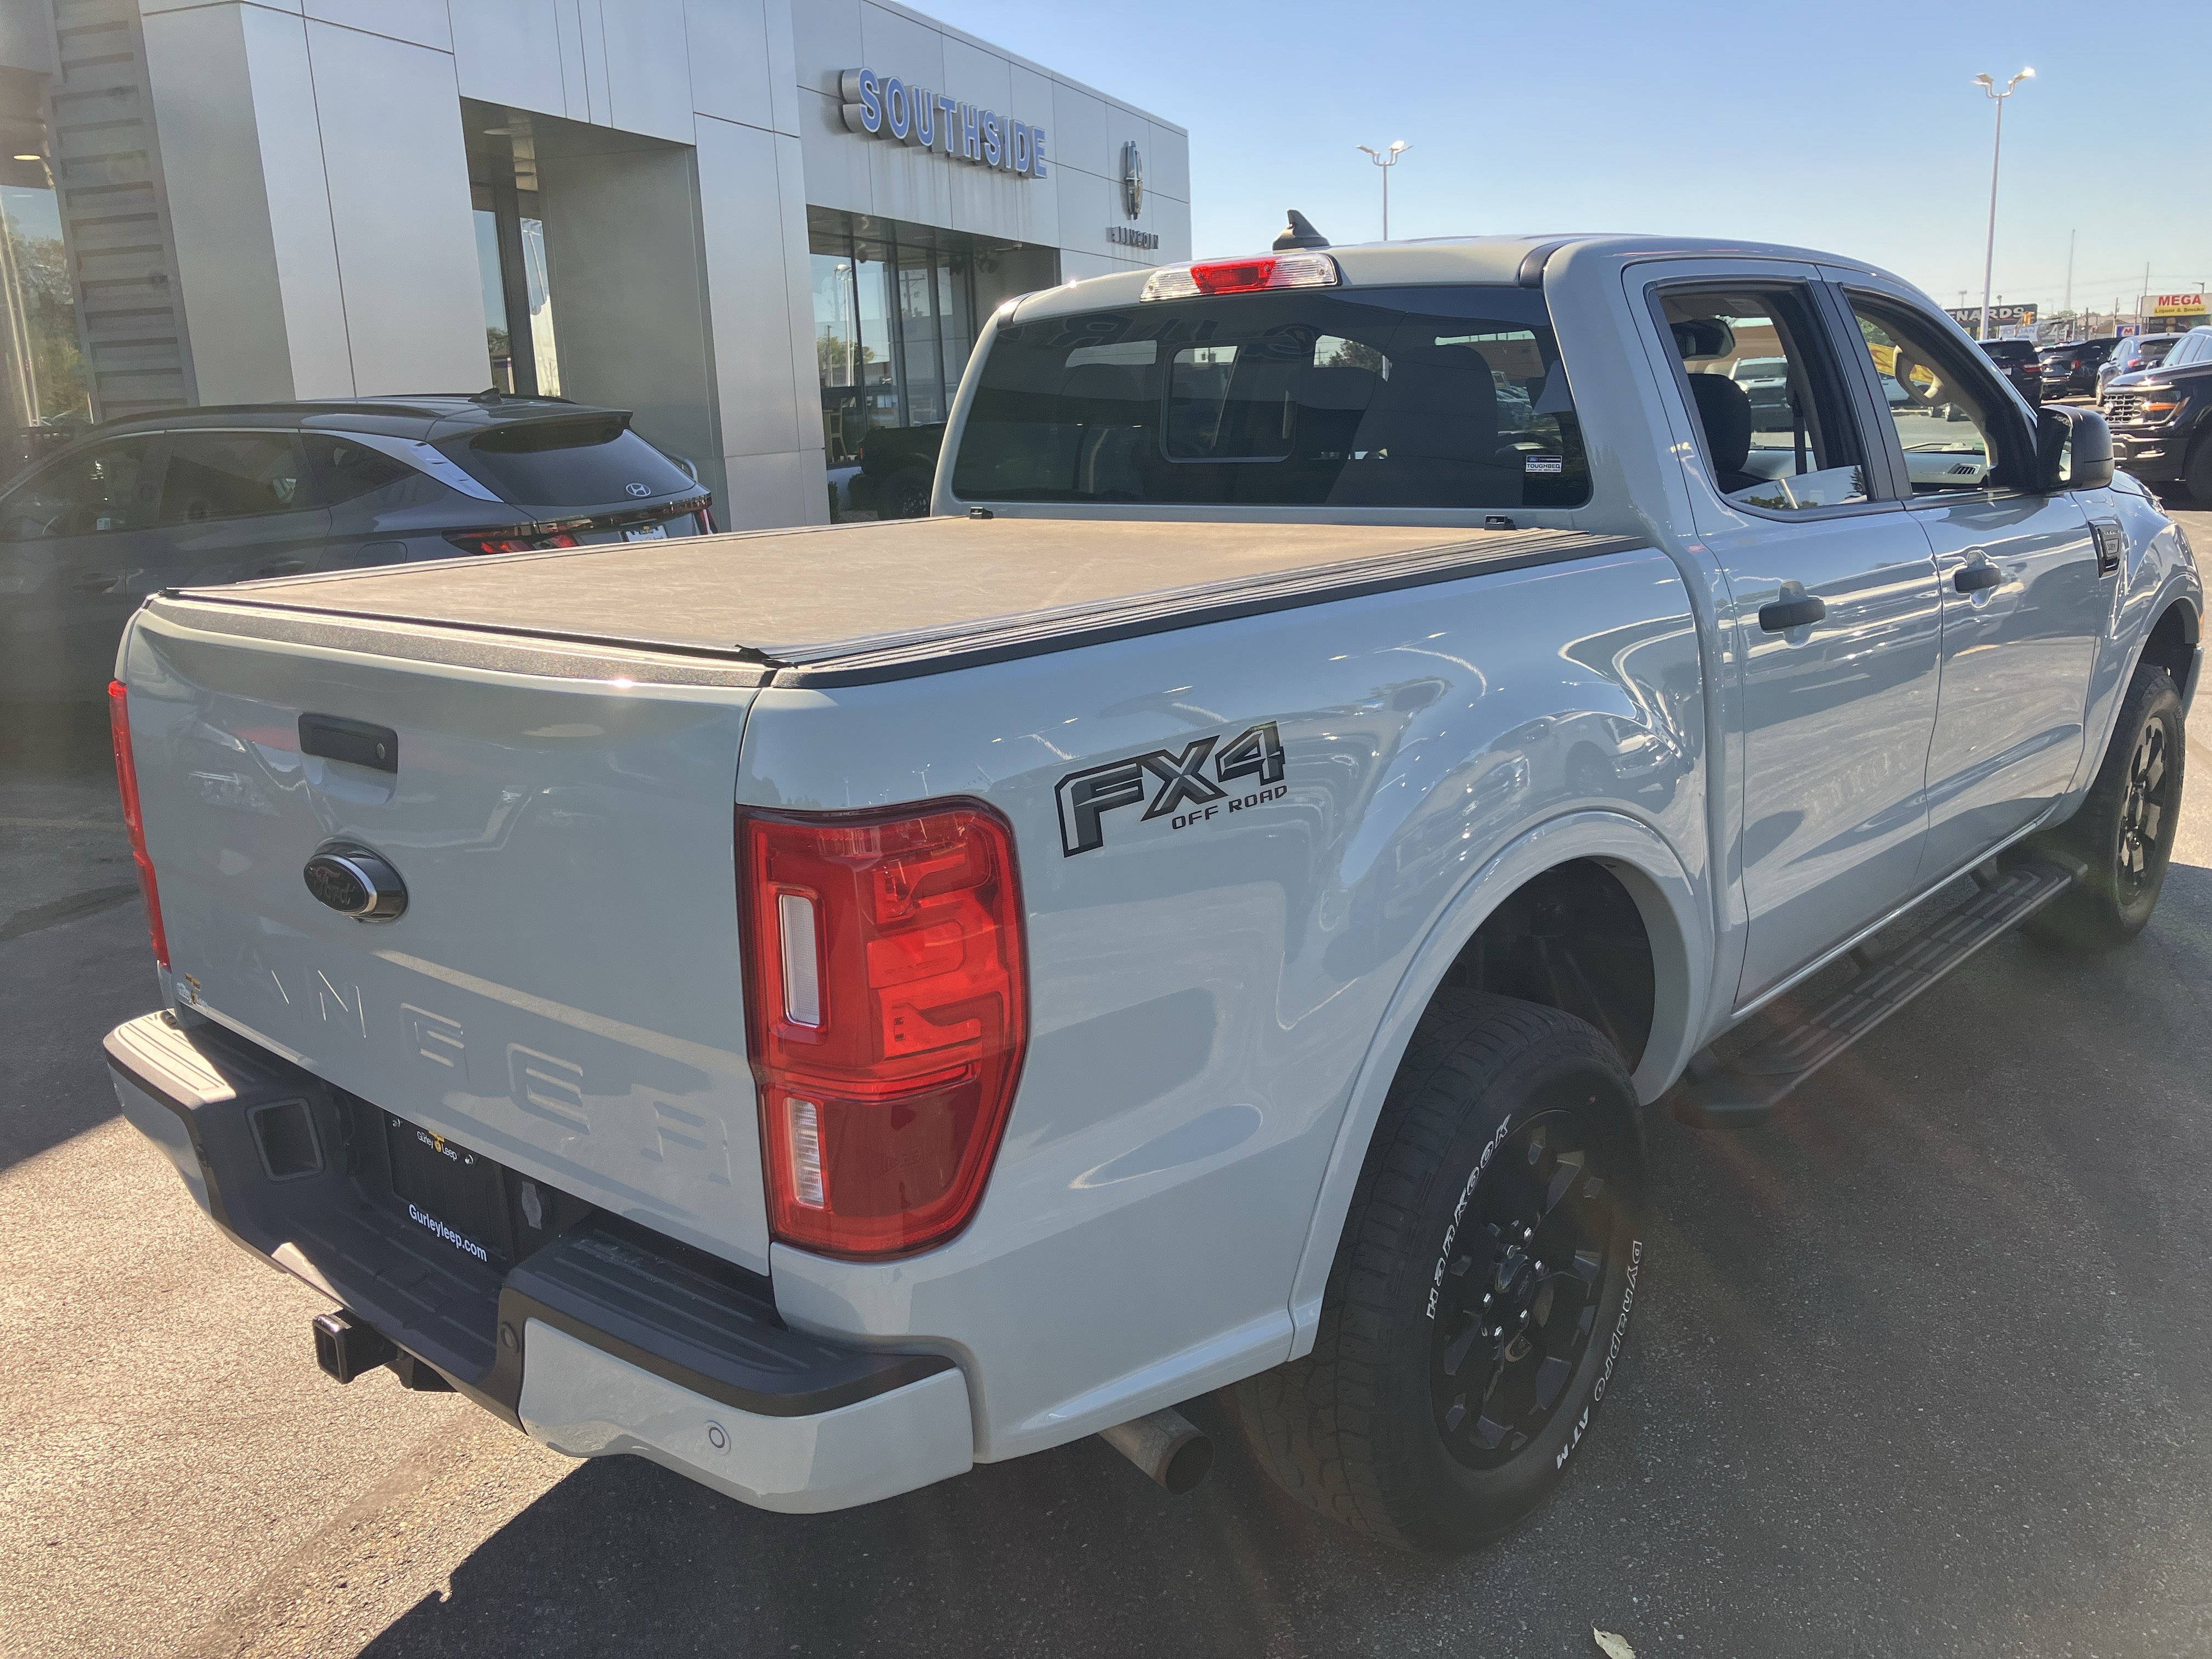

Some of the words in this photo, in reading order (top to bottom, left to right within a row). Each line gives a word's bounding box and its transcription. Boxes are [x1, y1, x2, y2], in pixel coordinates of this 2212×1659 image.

[842, 66, 1047, 180] SOUTHSIDE
[1948, 307, 2024, 321] ENARDS
[2158, 294, 2202, 306] MEGA
[2000, 327, 2035, 336] JODAN
[1054, 720, 1286, 859] FX4
[1171, 805, 1219, 830] OFF
[1228, 785, 1288, 813] ROAD
[314, 866, 356, 906] Ford
[441, 1143, 458, 1161] Leep
[409, 1204, 487, 1262] Gurleyleep.com
